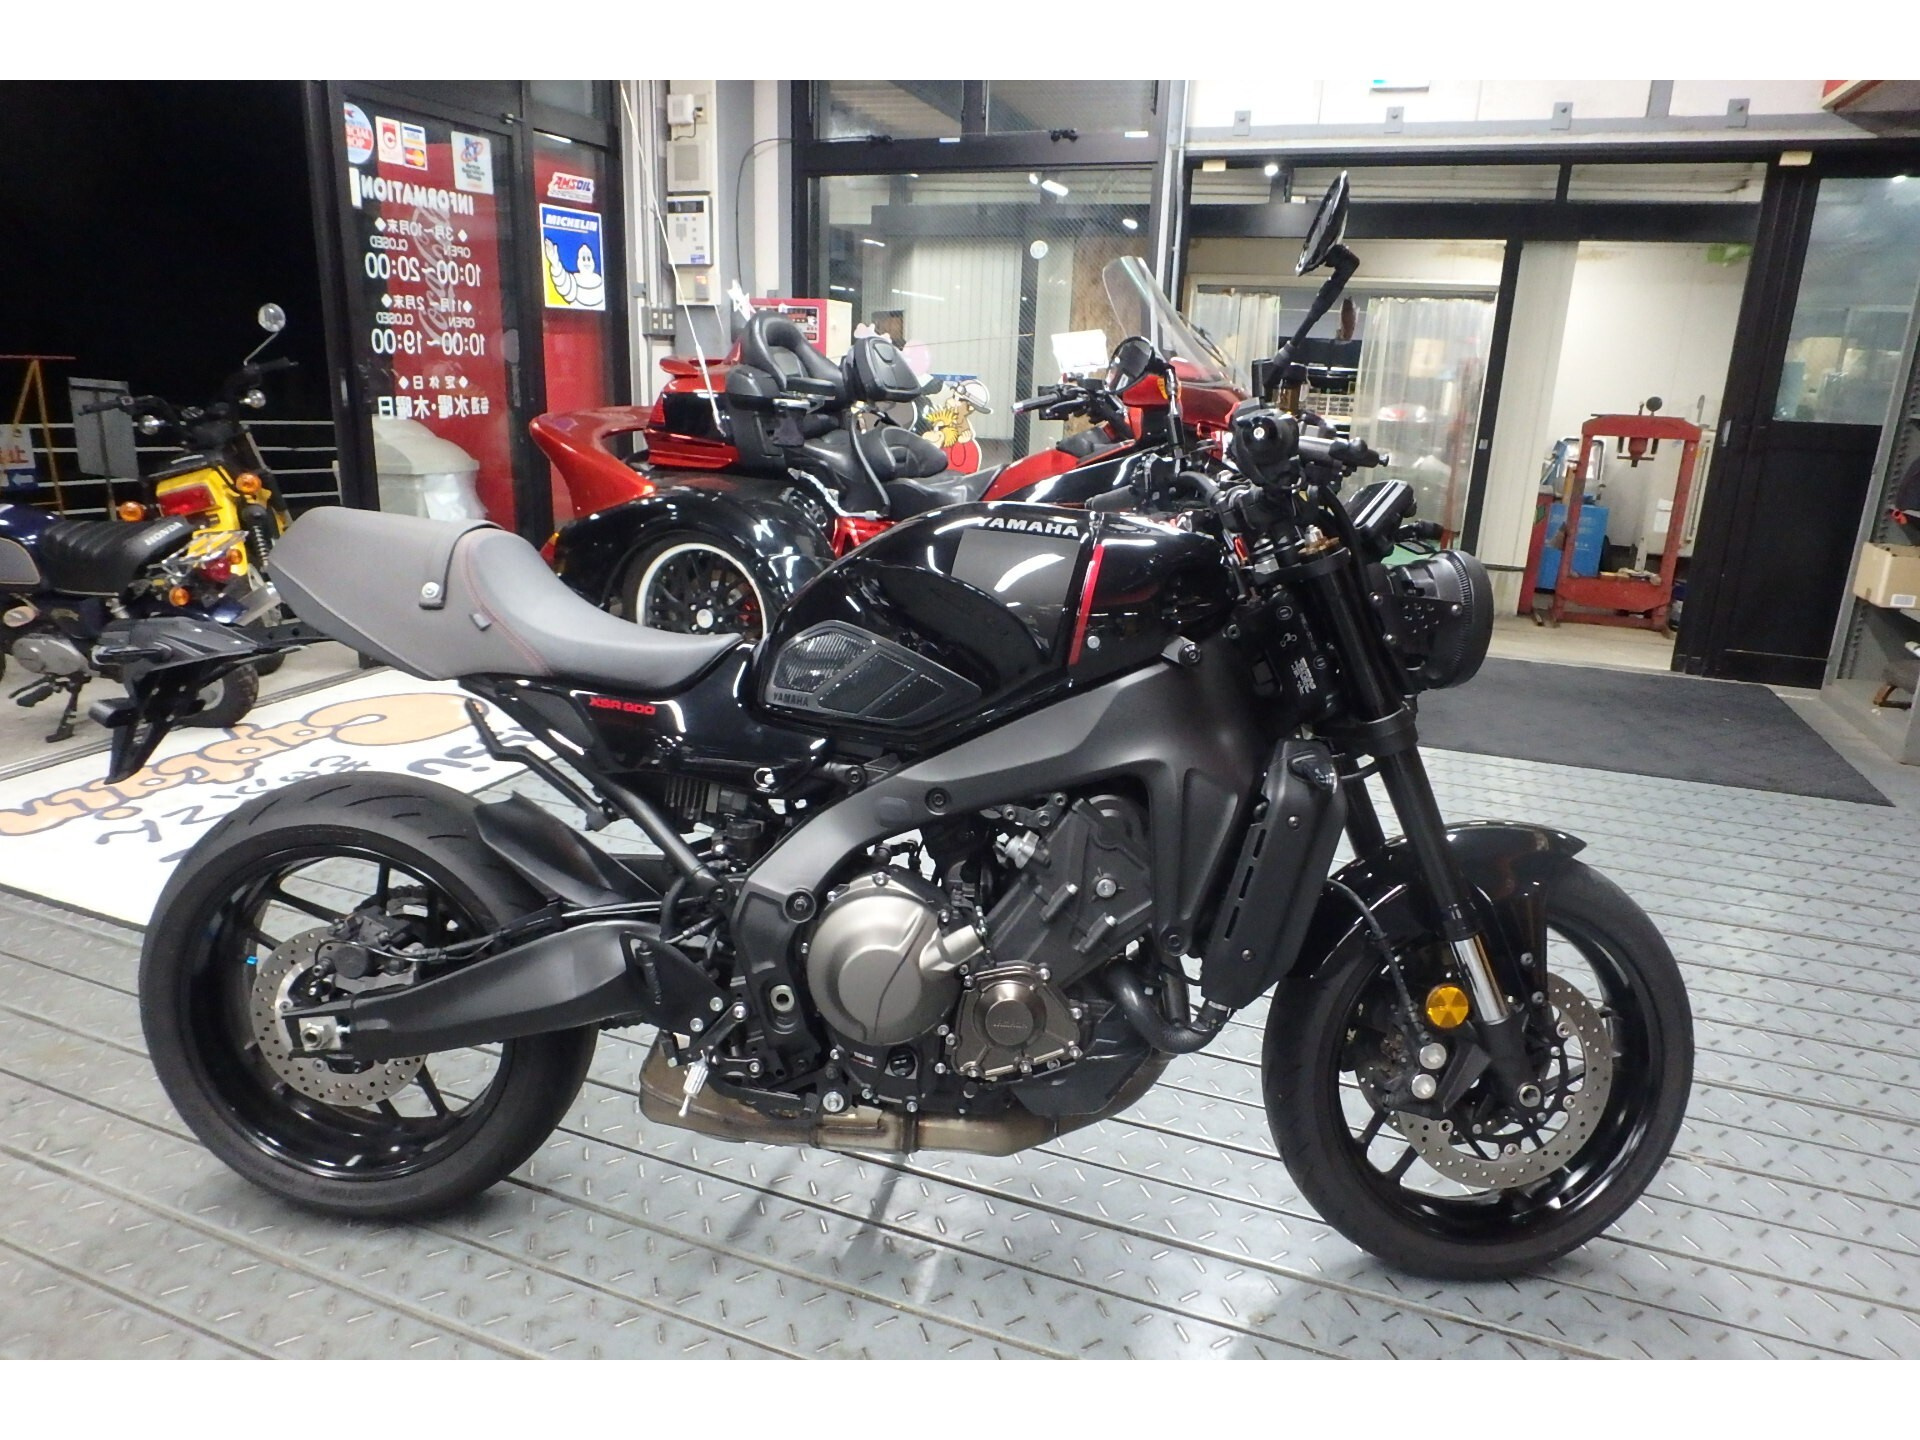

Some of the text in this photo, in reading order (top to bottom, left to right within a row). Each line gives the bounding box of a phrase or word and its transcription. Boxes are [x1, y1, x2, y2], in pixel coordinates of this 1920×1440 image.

[553, 175, 592, 192] AMSOIL
[545, 213, 598, 232] MICHELIN
[144, 521, 184, 547] HONDA
[977, 516, 1080, 538] YAMAHA
[773, 691, 809, 707] YAMAHA
